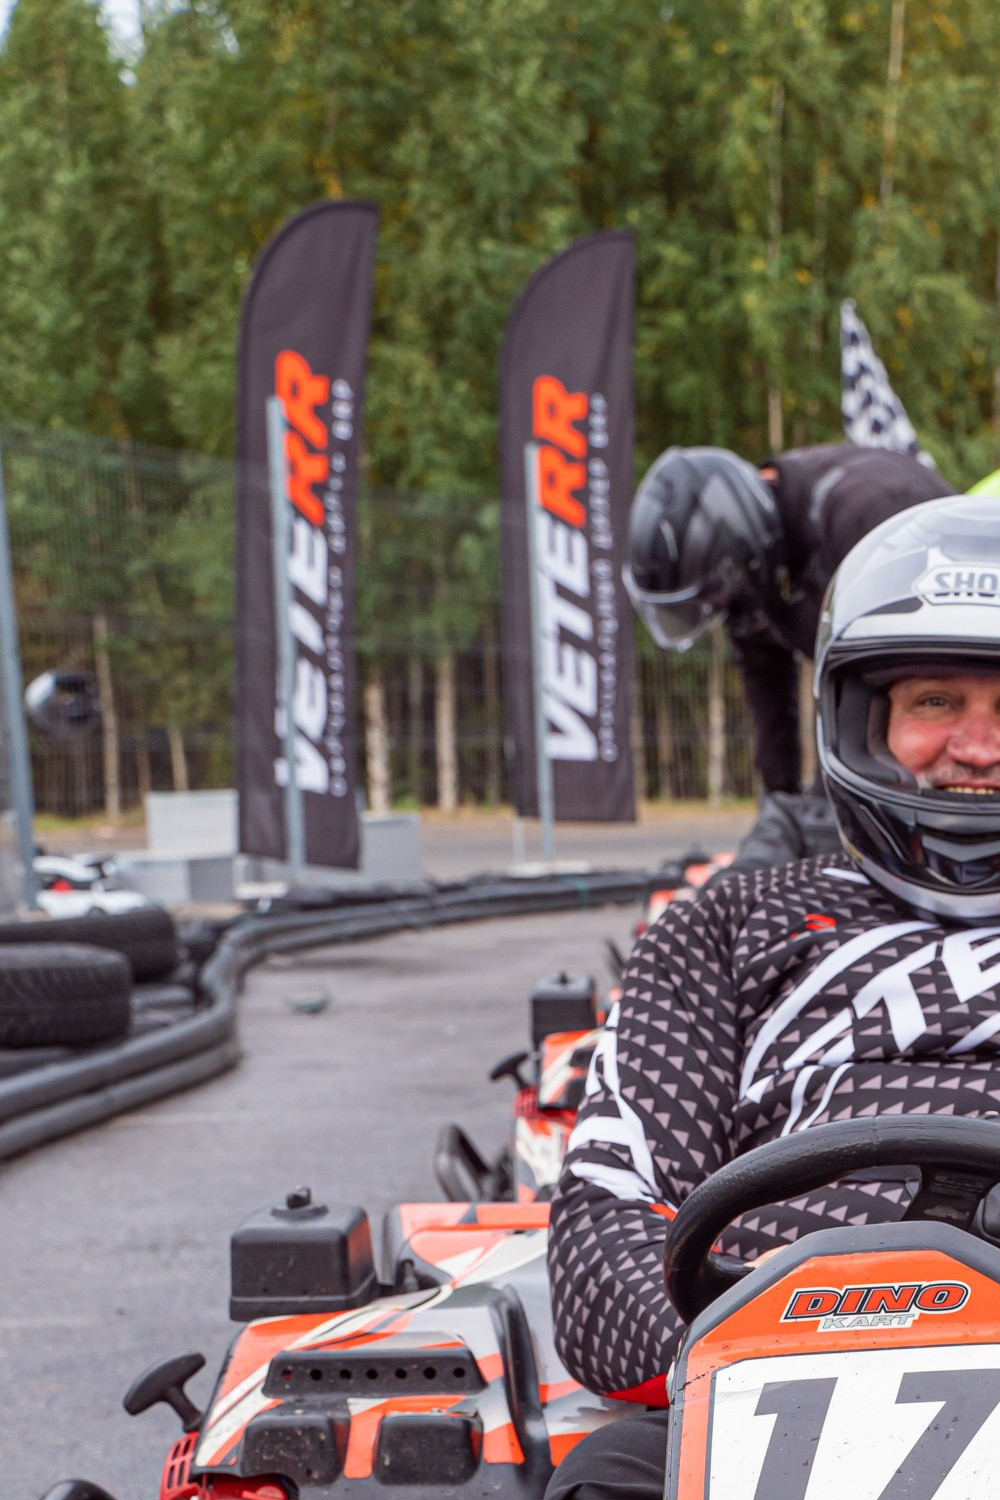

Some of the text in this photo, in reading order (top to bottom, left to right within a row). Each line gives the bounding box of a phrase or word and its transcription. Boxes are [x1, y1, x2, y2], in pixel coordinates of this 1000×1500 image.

[532, 375, 598, 762] VETERR
[784, 1283, 969, 1320] DINO
[822, 1313, 916, 1330] KART
